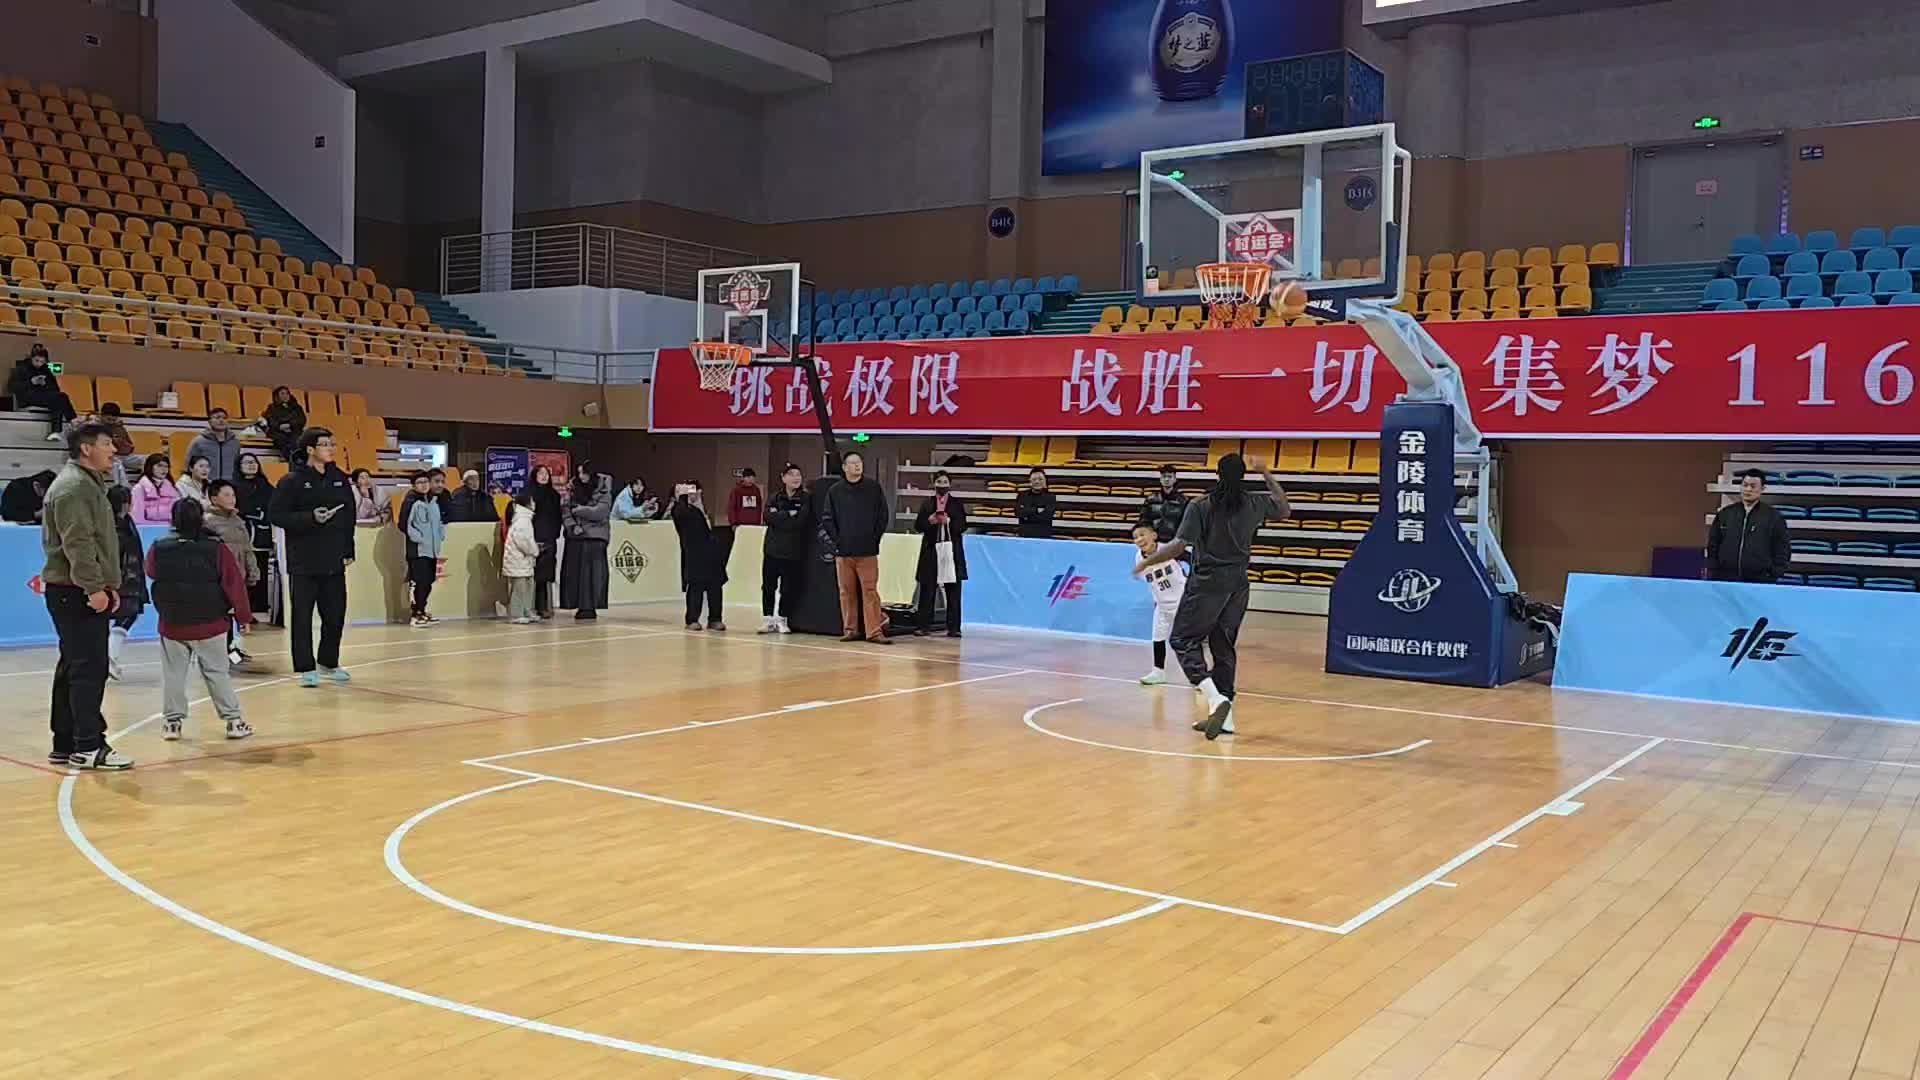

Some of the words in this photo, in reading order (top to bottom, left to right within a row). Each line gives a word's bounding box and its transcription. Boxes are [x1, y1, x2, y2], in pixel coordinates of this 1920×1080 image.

[728, 351, 961, 417] 挑战极限
[1061, 340, 1379, 417] 战胜一切
[1480, 331, 1676, 417] 集梦
[1726, 340, 1916, 406] 116
[1396, 430, 1427, 542] 金陵体育
[1157, 579, 1172, 592] 30
[1346, 634, 1469, 659] 国际篮联合作伙伴
